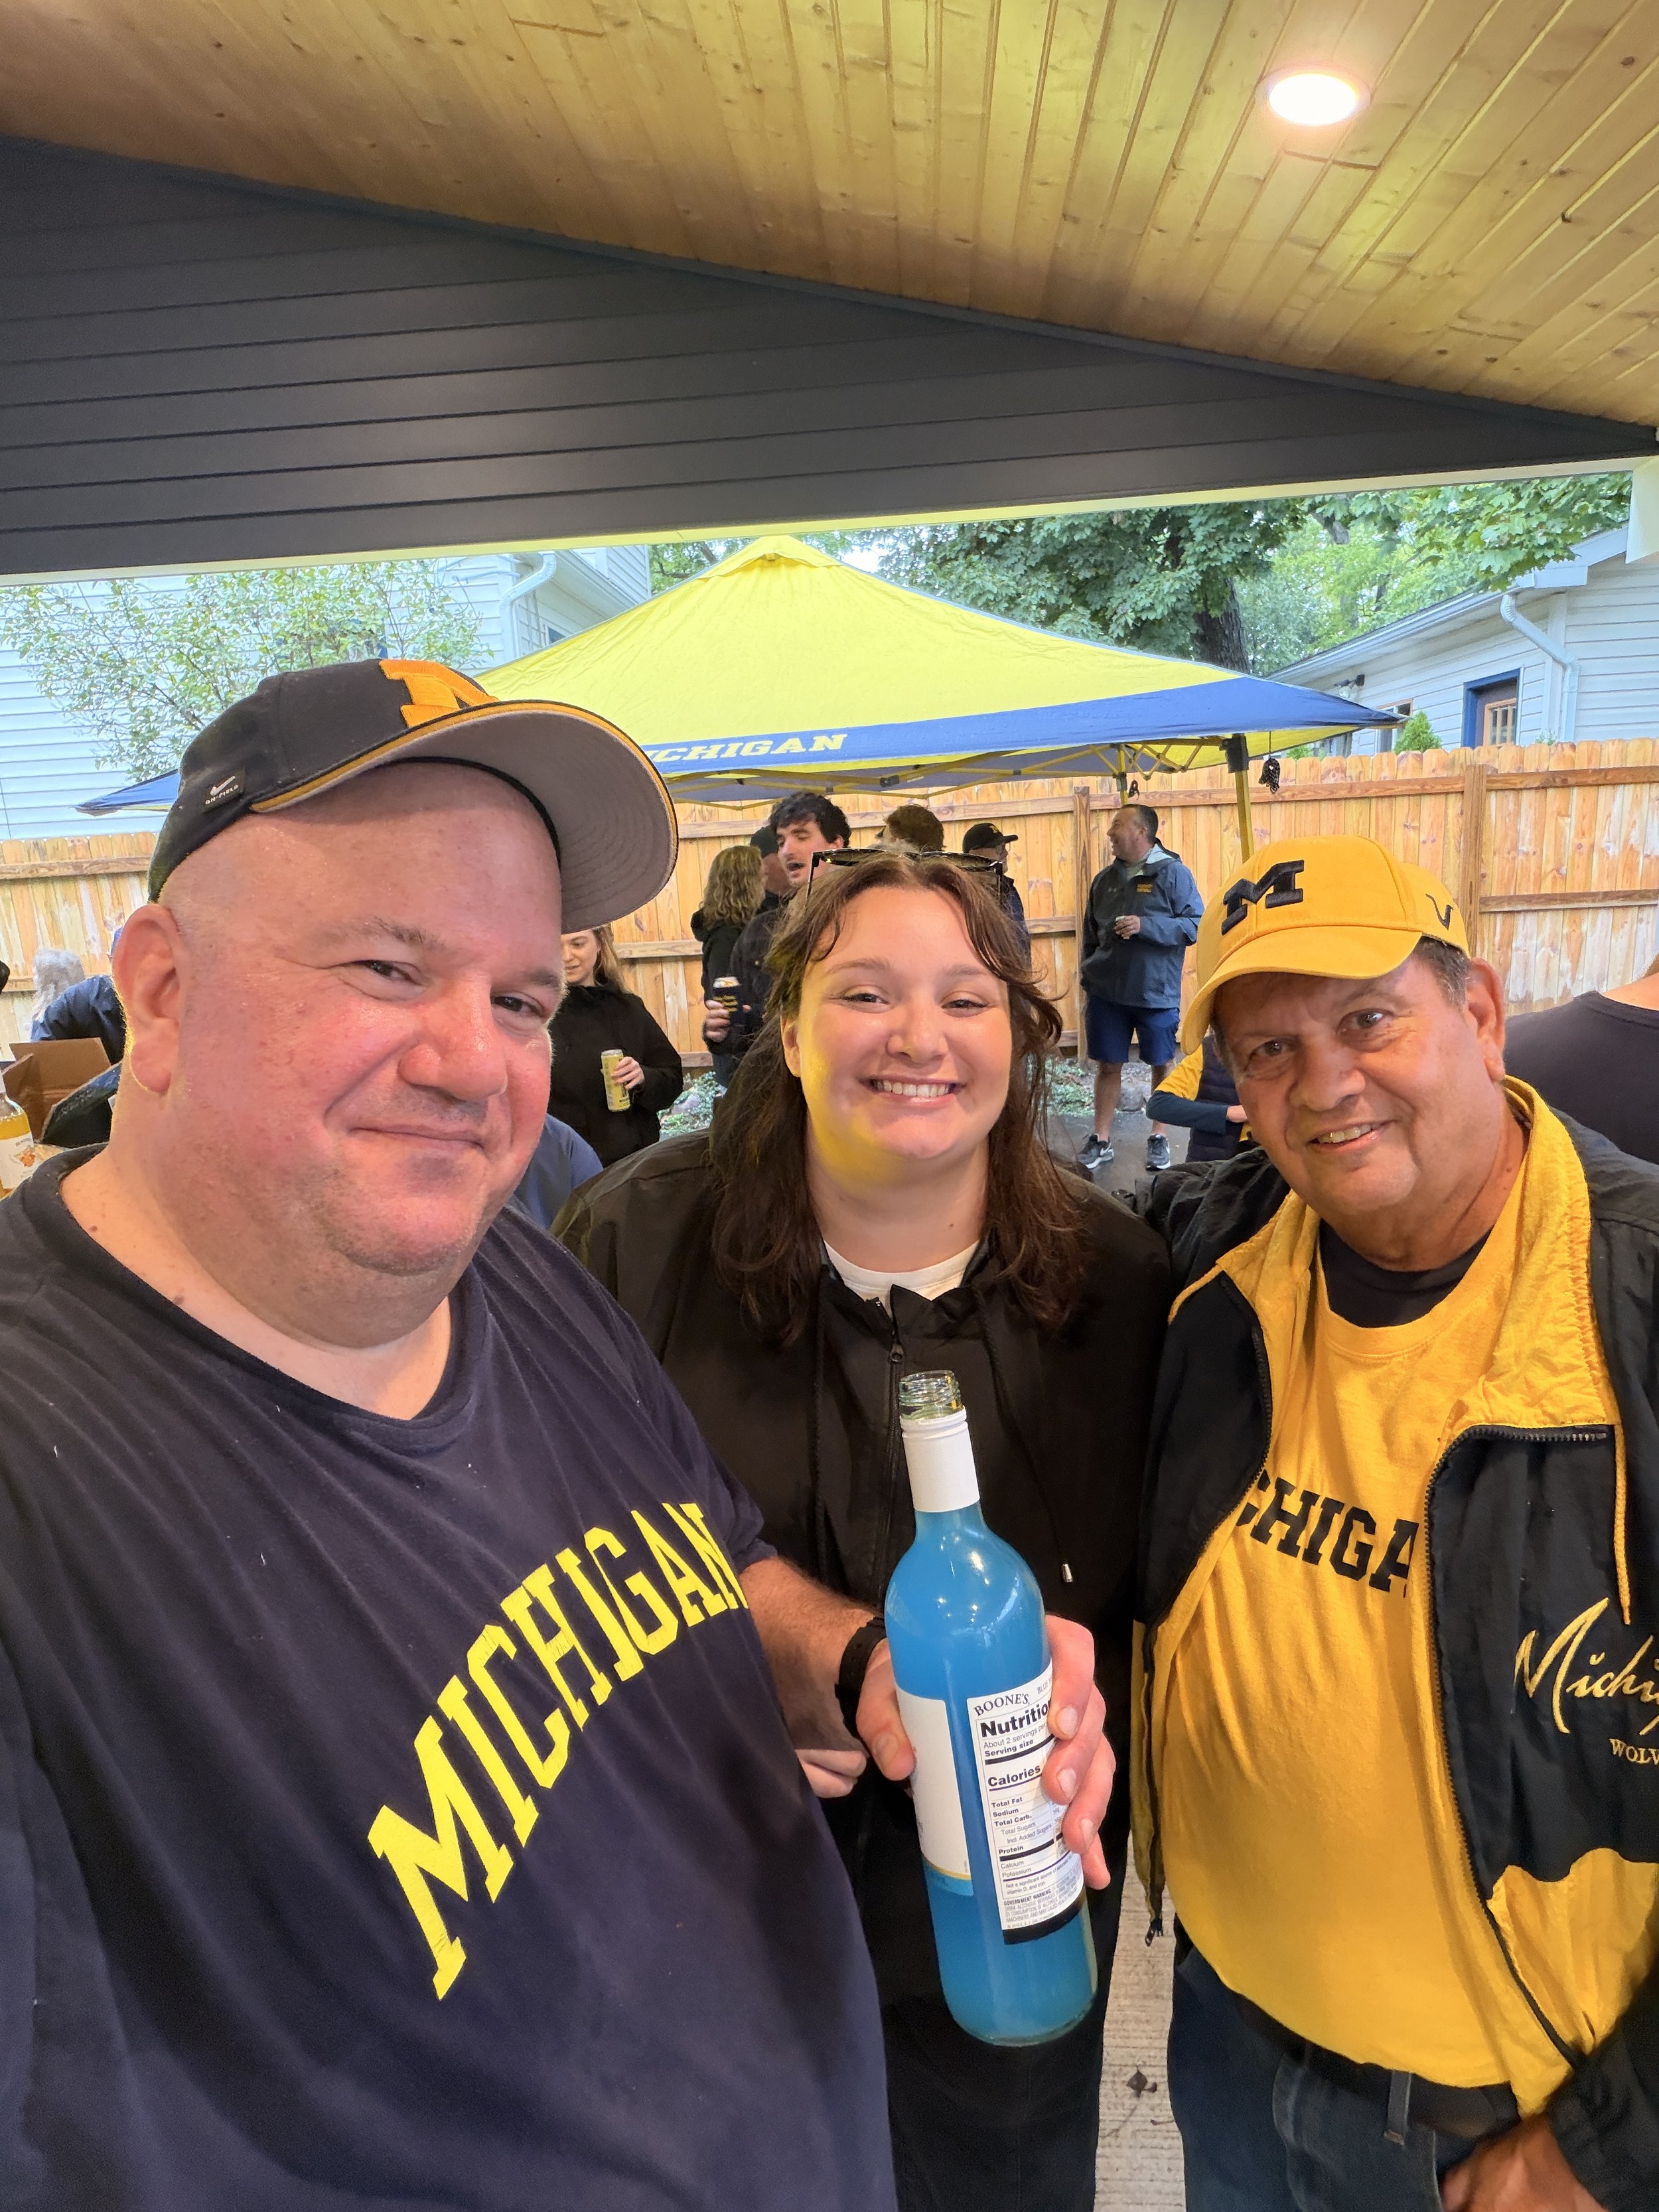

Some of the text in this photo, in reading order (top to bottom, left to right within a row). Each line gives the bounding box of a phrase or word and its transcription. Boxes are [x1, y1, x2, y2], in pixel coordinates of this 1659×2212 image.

[1221, 859, 1305, 935] M
[974, 1693, 1029, 1716] BOONE'S
[983, 1739, 1005, 1749] About
[1013, 1728, 1037, 1741] servings
[367, 1503, 748, 2000] MICHIGAN
[985, 1739, 1033, 1757] Serving size
[988, 1764, 1041, 1787] Calories
[991, 1799, 1009, 1808] Total
[993, 1808, 1019, 1817] Sodium
[1015, 1814, 1032, 1823] Carb.
[1001, 1827, 1016, 1836] Total
[999, 1845, 1023, 1855] Protein
[1001, 1860, 1024, 1869] Calcium
[1002, 1868, 1032, 1878] Potassium
[1004, 1895, 1032, 1906] GOVERNMENT
